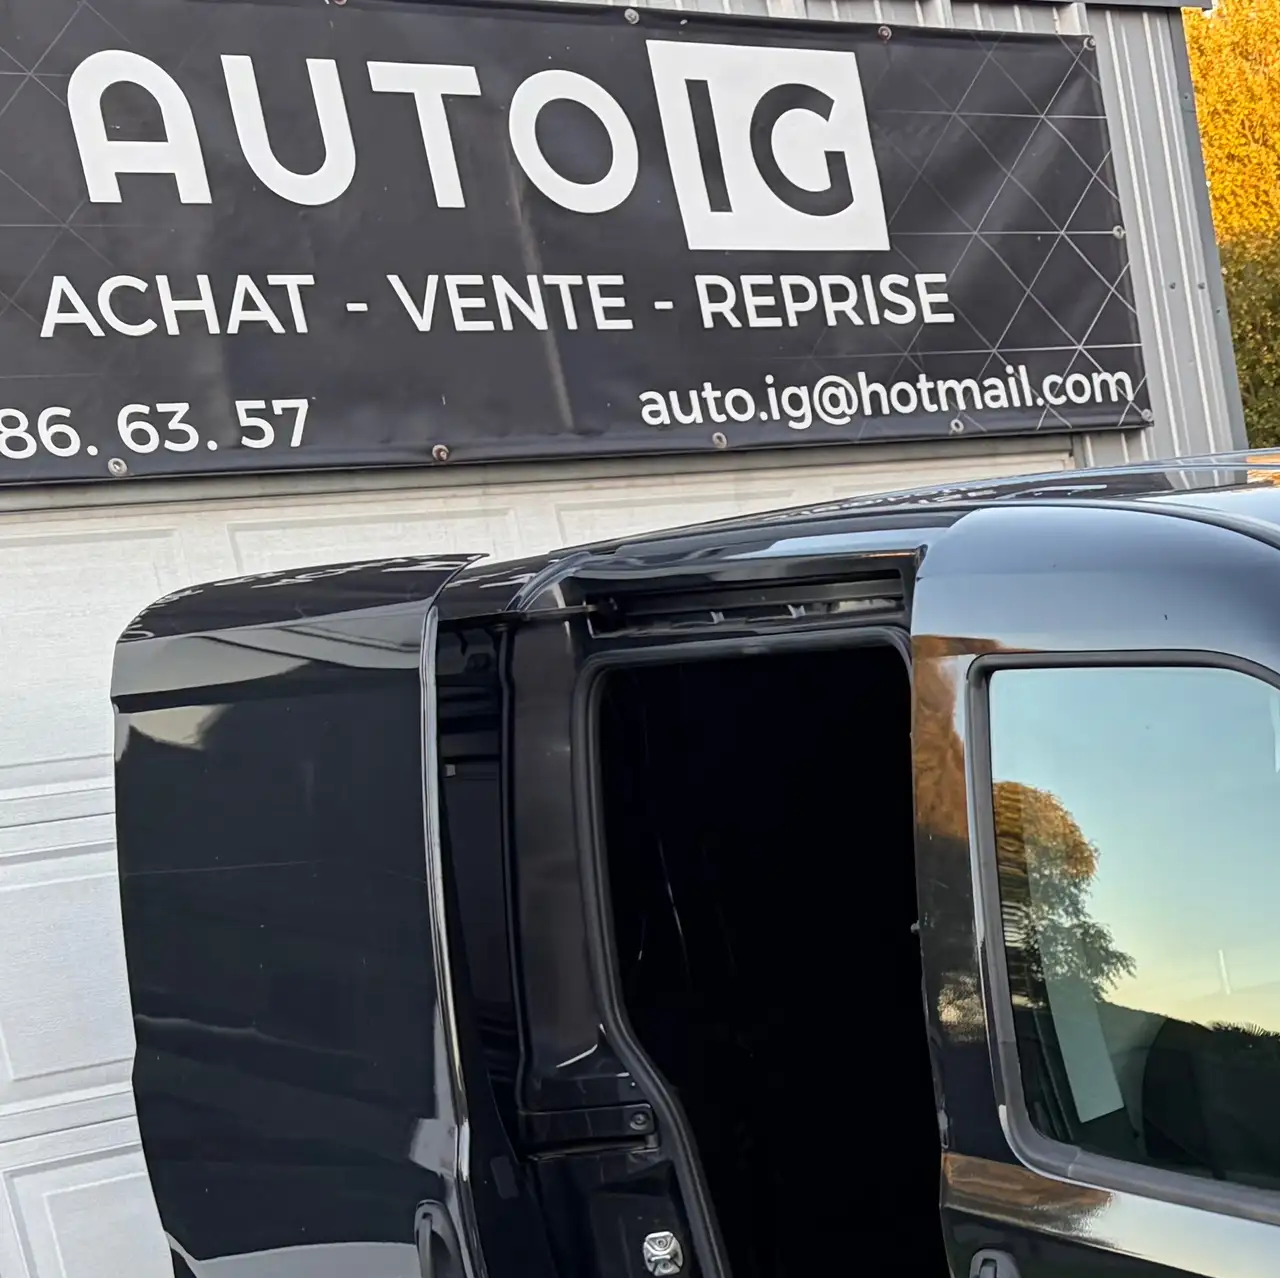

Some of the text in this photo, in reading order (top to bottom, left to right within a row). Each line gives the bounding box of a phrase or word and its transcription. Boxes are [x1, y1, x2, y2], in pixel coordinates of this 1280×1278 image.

[67, 49, 639, 214] AUTO
[40, 274, 315, 338] ACHAT
[386, 274, 634, 332] VENTE
[694, 273, 955, 329] REPRISE
[117, 402, 218, 454] 63.
[234, 398, 309, 449] 57
[638, 364, 1135, 430] auto.ig@hotmail.com
